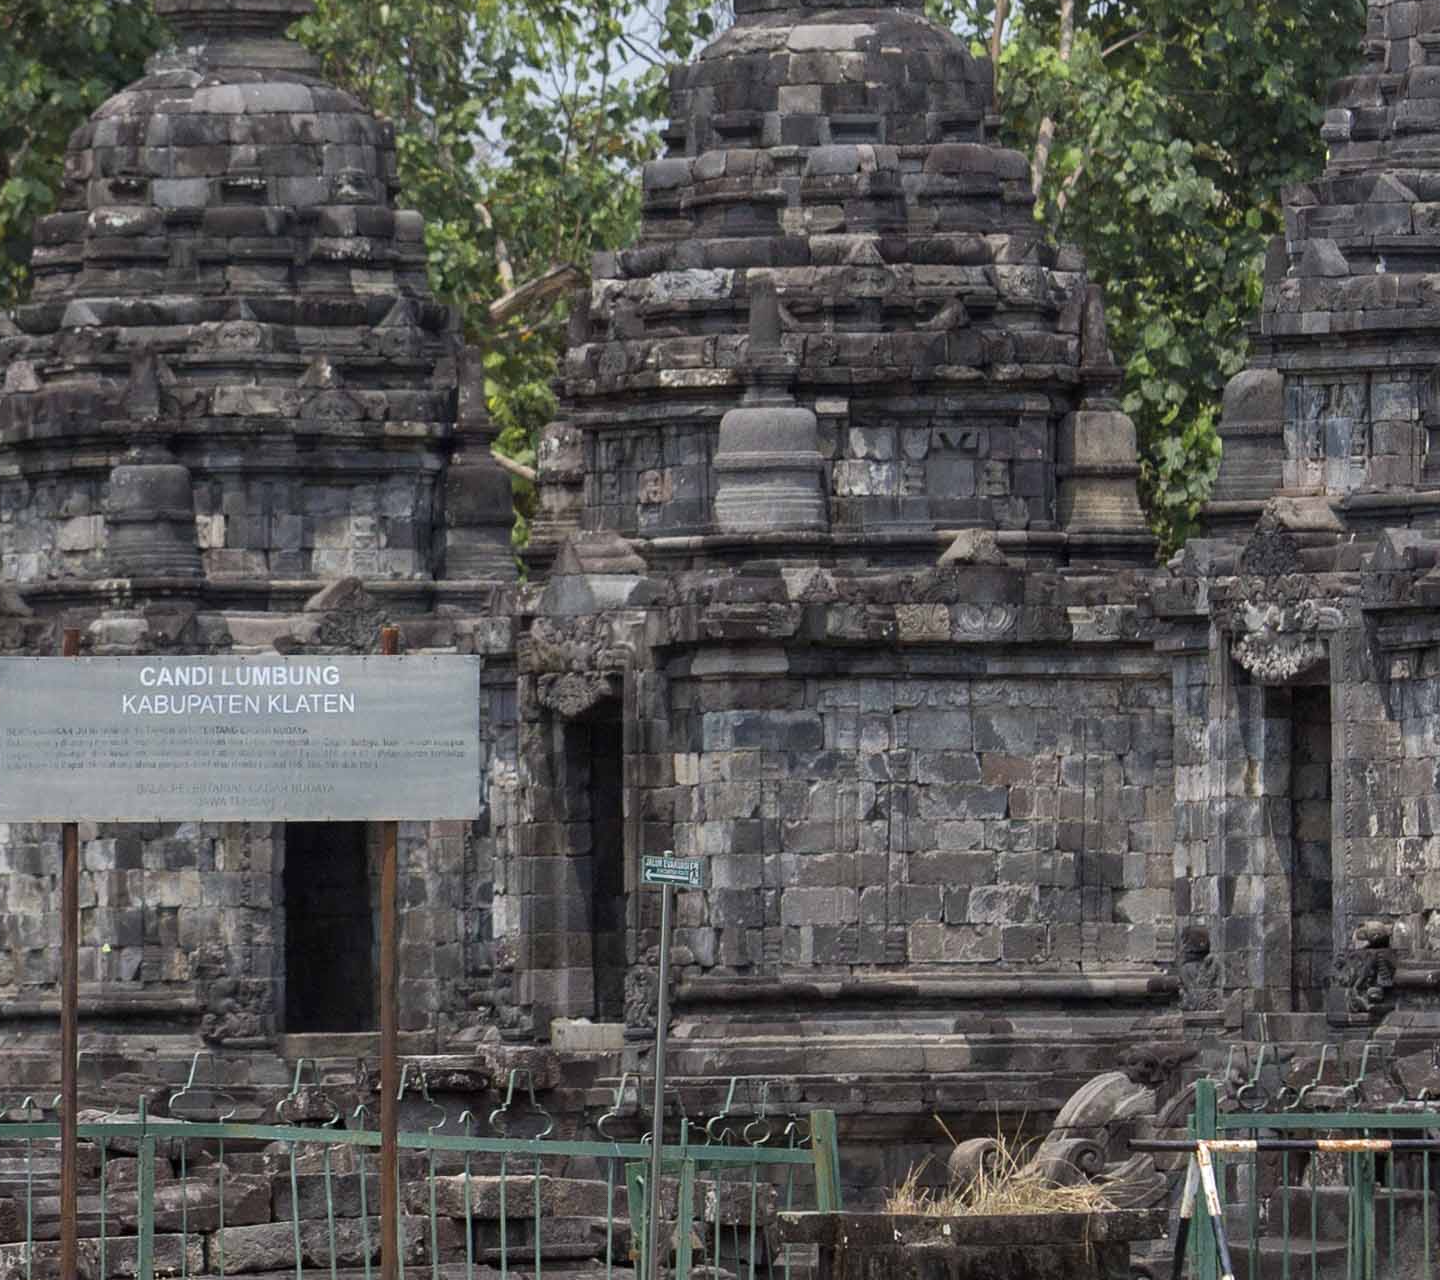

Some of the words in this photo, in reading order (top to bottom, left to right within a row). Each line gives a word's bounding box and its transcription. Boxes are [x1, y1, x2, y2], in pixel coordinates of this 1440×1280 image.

[140, 666, 212, 686] CANDI
[222, 666, 340, 686] LUMBUNG
[122, 695, 260, 714] KABUPATEN
[268, 694, 355, 713] KLATEN
